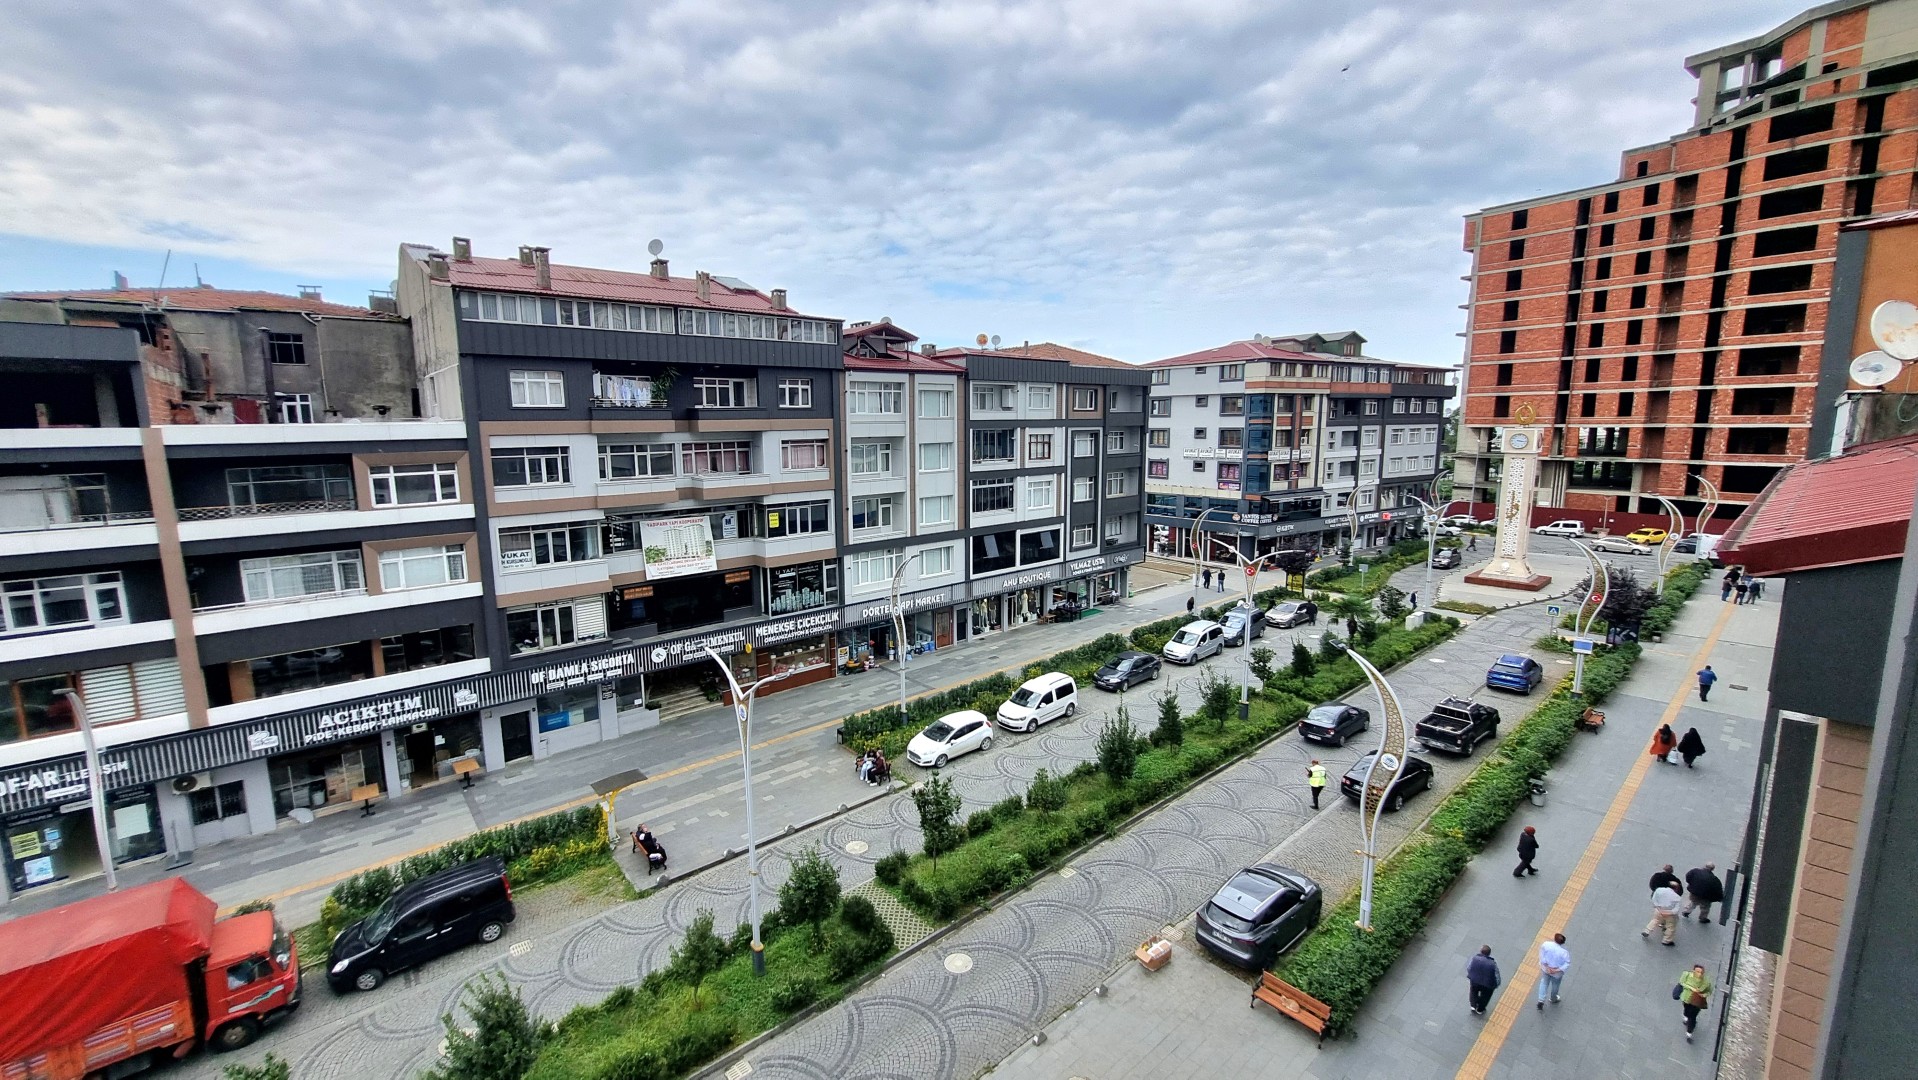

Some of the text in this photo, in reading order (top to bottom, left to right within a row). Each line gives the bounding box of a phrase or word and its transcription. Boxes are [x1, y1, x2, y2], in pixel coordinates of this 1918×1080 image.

[1070, 560, 1092, 571] YILMAZ
[1092, 557, 1105, 567] USTA
[1003, 571, 1051, 588] AHU BOUTIQUE
[915, 593, 945, 607] MARKET
[755, 620, 796, 637] MENEKŞE
[531, 671, 546, 684] OF
[548, 662, 589, 681] DAMLA
[590, 653, 635, 672] SİGORTA
[318, 696, 423, 729] ACIKTIM
